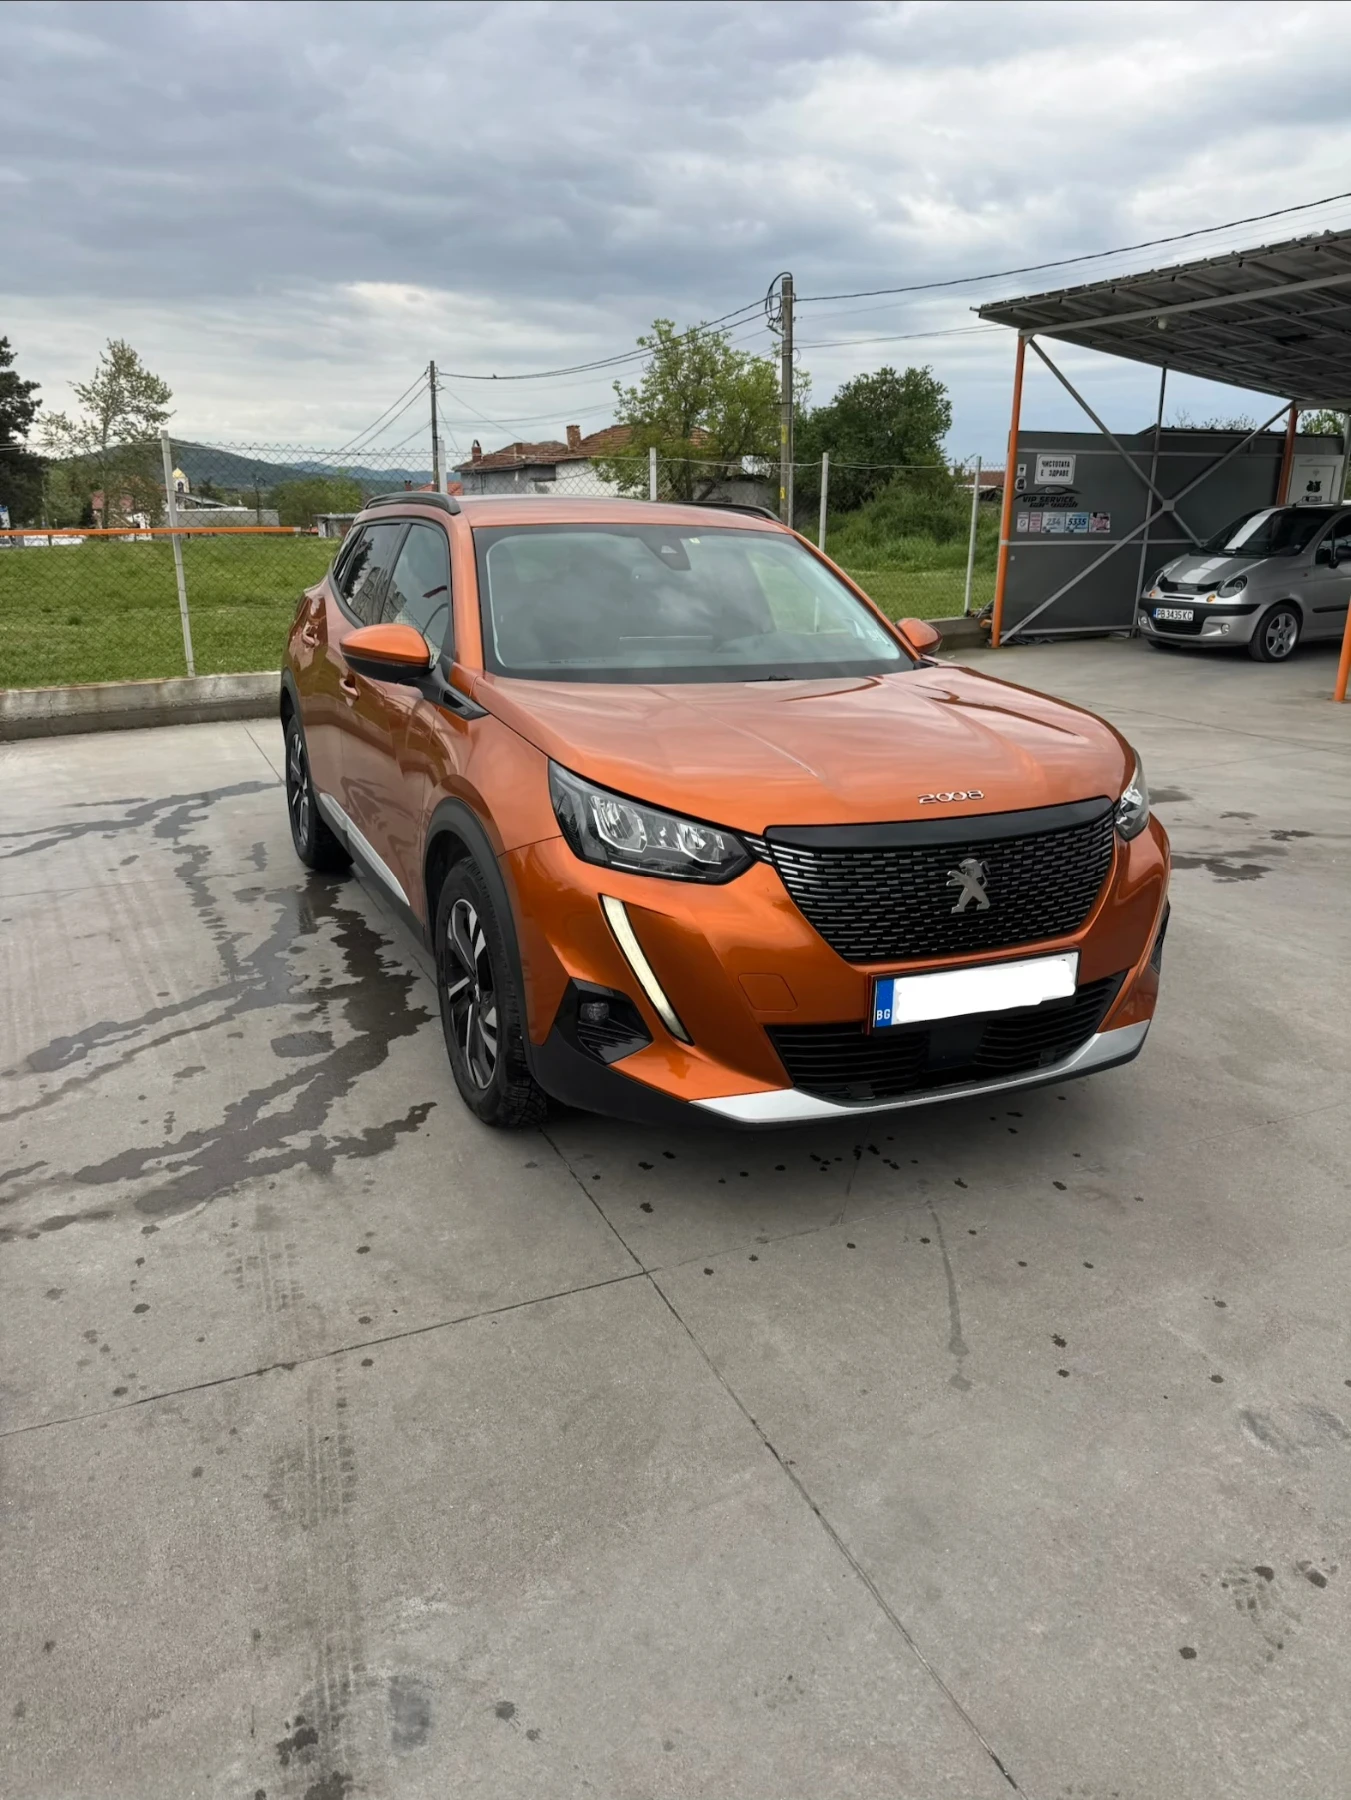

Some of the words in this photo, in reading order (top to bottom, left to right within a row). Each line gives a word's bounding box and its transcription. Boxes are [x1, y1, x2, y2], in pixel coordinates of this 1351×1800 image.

[1041, 460, 1070, 468] ЧИСТОТАТА
[917, 789, 985, 804] 2008
[876, 1008, 891, 1021] BG
